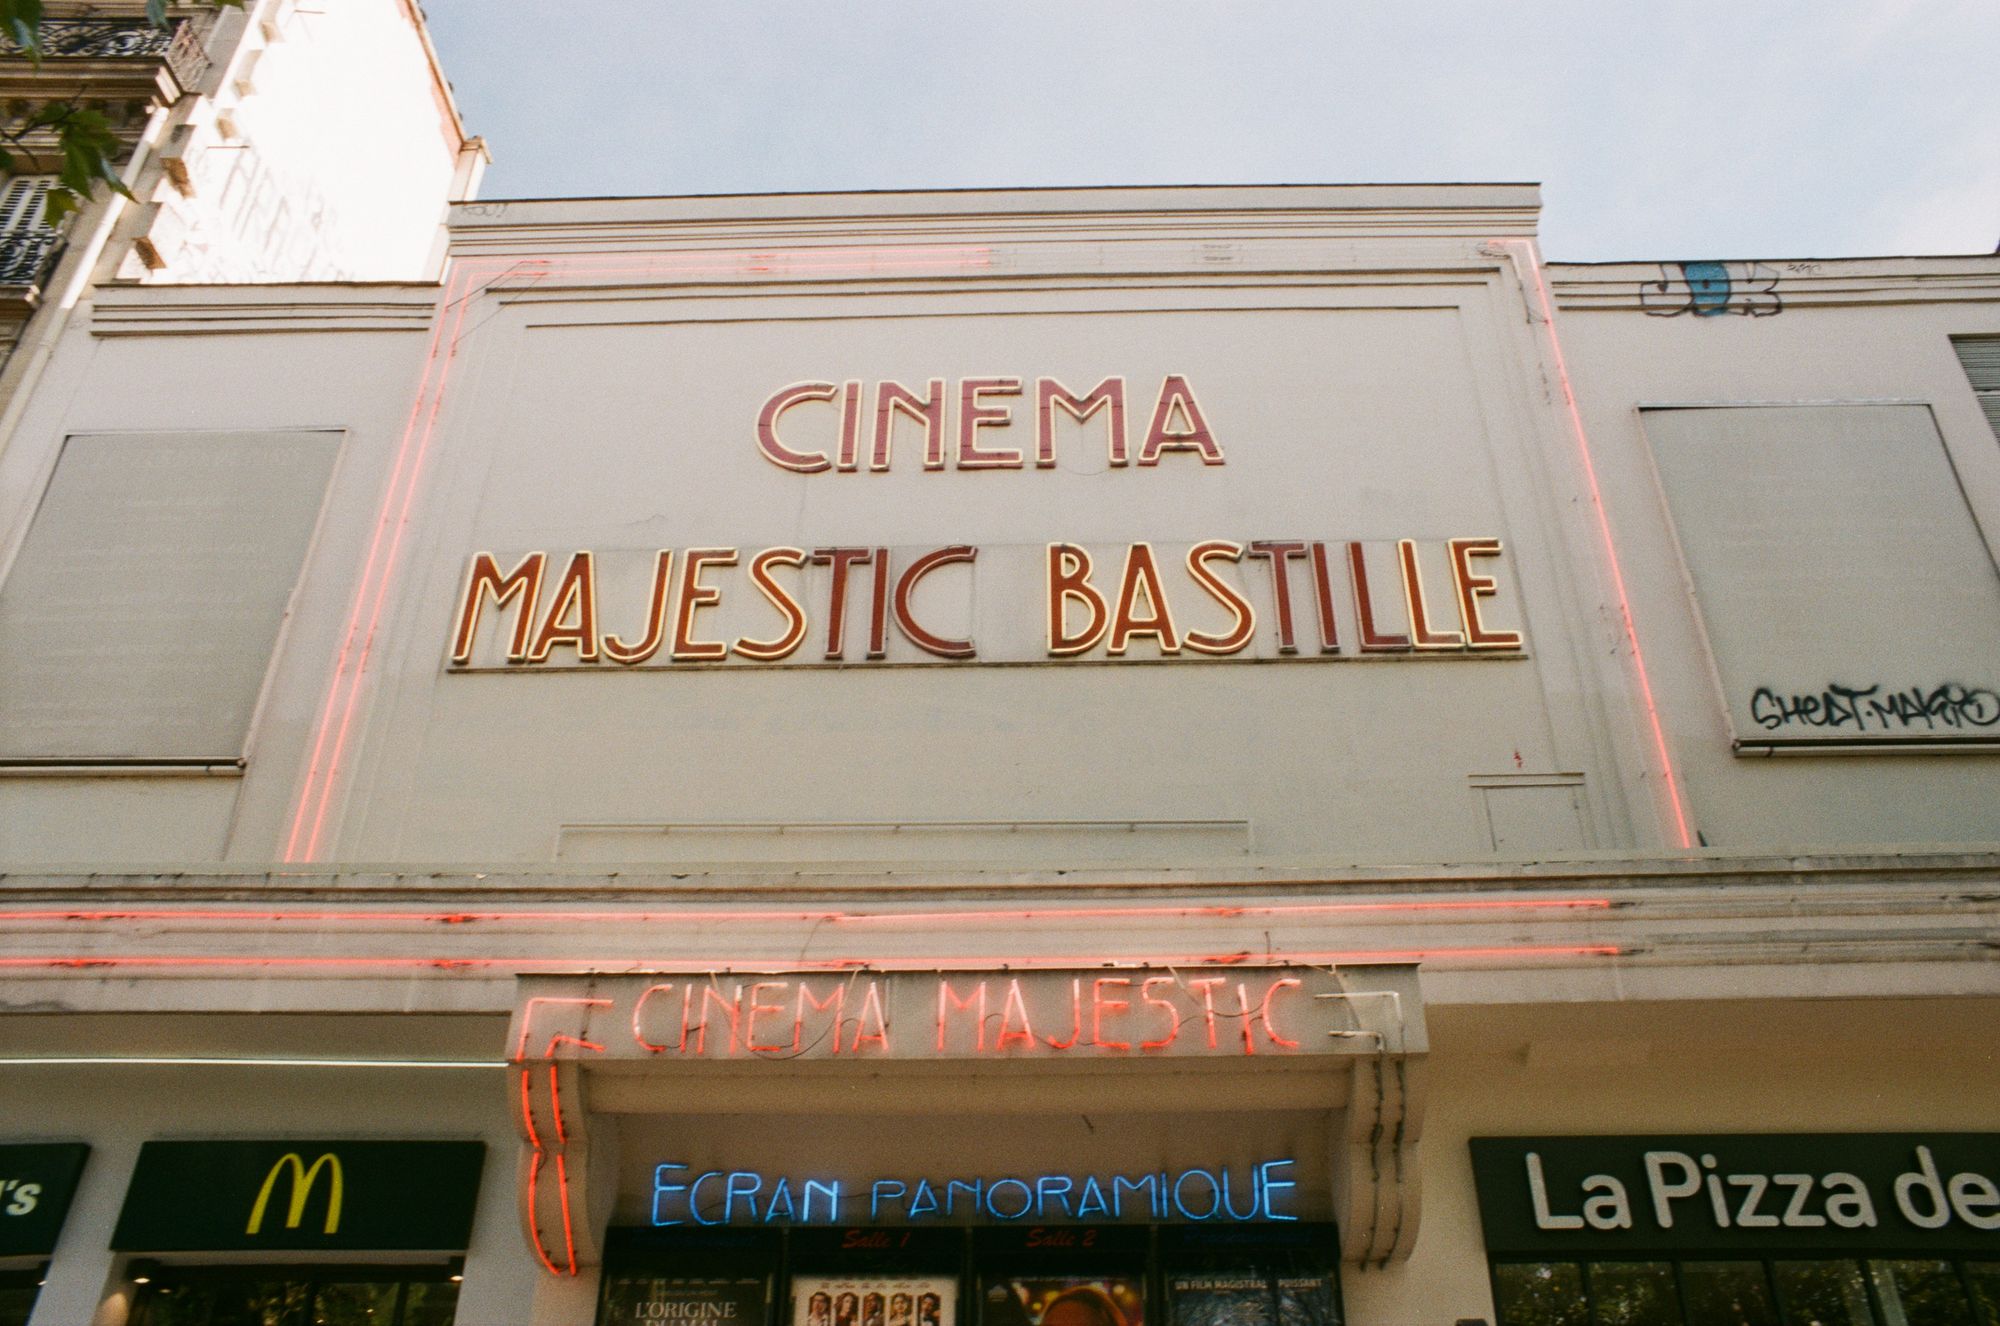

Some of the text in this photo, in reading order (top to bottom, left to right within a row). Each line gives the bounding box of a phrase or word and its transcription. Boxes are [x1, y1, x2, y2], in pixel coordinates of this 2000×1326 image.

[754, 375, 1226, 474] CINEMA
[452, 538, 1524, 663] MAJESTIC BASTILLE
[633, 977, 1301, 1056] CINEMA MAJESTIC
[0, 1179, 42, 1216] 's
[651, 1159, 1299, 1227] ECRAN PANORAMIQUE
[1526, 1144, 2000, 1230] La Pizza de
[841, 1229, 891, 1249] Salle
[1024, 1226, 1098, 1248] Salle 2
[635, 1301, 738, 1319] L'ORIGINE
